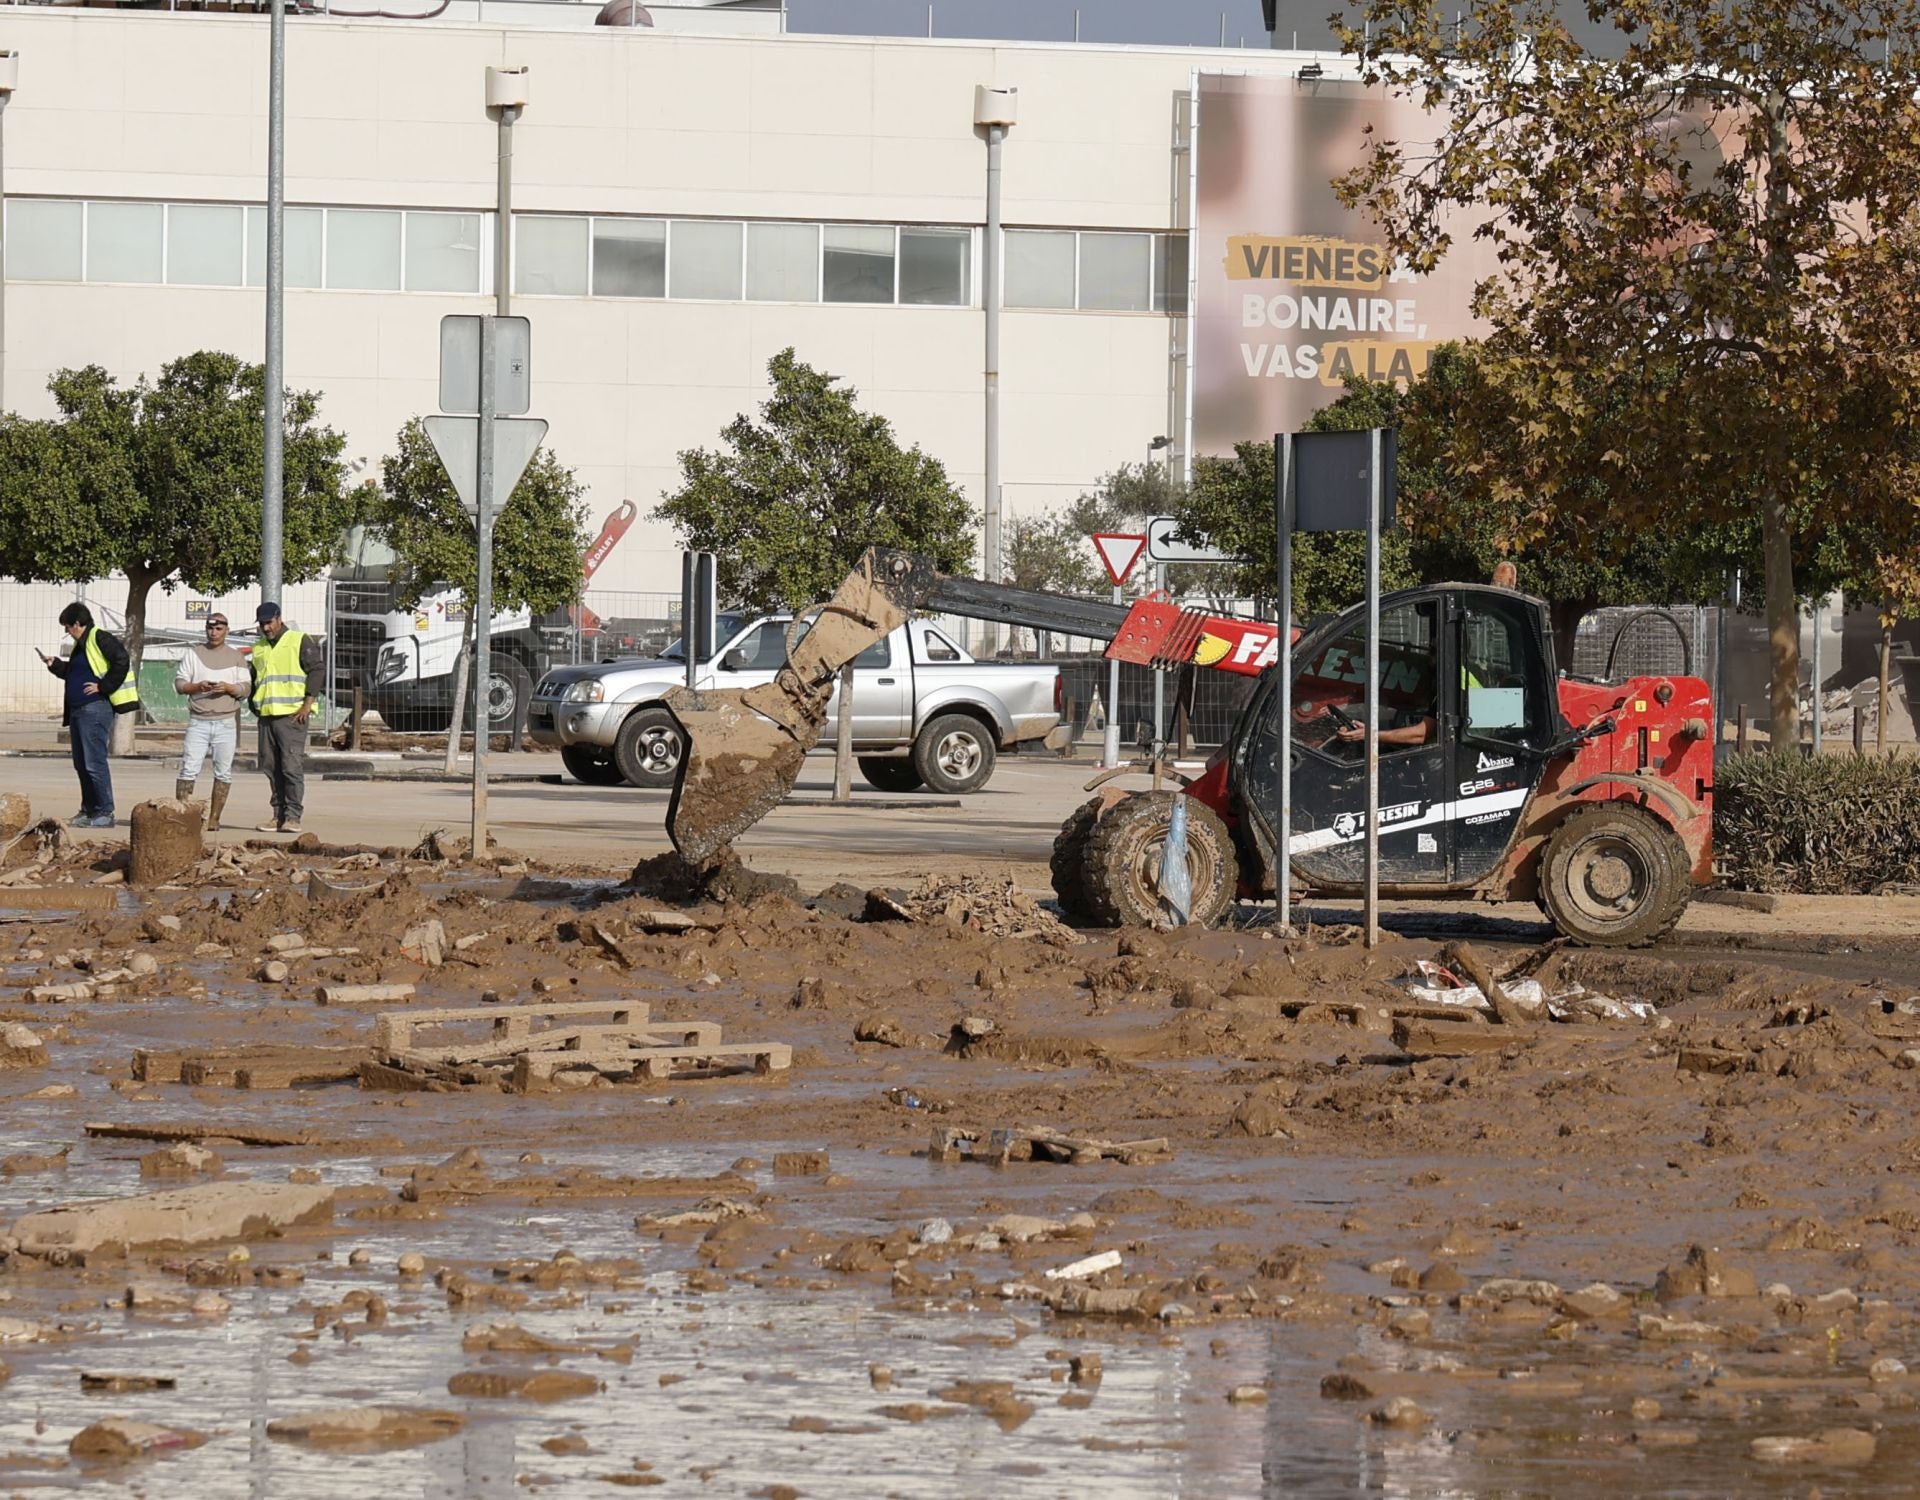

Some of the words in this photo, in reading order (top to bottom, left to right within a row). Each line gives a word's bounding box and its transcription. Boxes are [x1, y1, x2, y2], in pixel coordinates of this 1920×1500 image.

[1242, 245, 1380, 283] VIENES
[1242, 294, 1428, 339] BONAIRE,
[1240, 343, 1319, 379] VAS
[1327, 347, 1356, 379] A
[1367, 348, 1415, 382] LA
[187, 602, 210, 612] SPV
[447, 604, 467, 614] SP
[670, 602, 682, 612] SP
[1476, 752, 1514, 769] Abarca
[1460, 778, 1495, 796] 626
